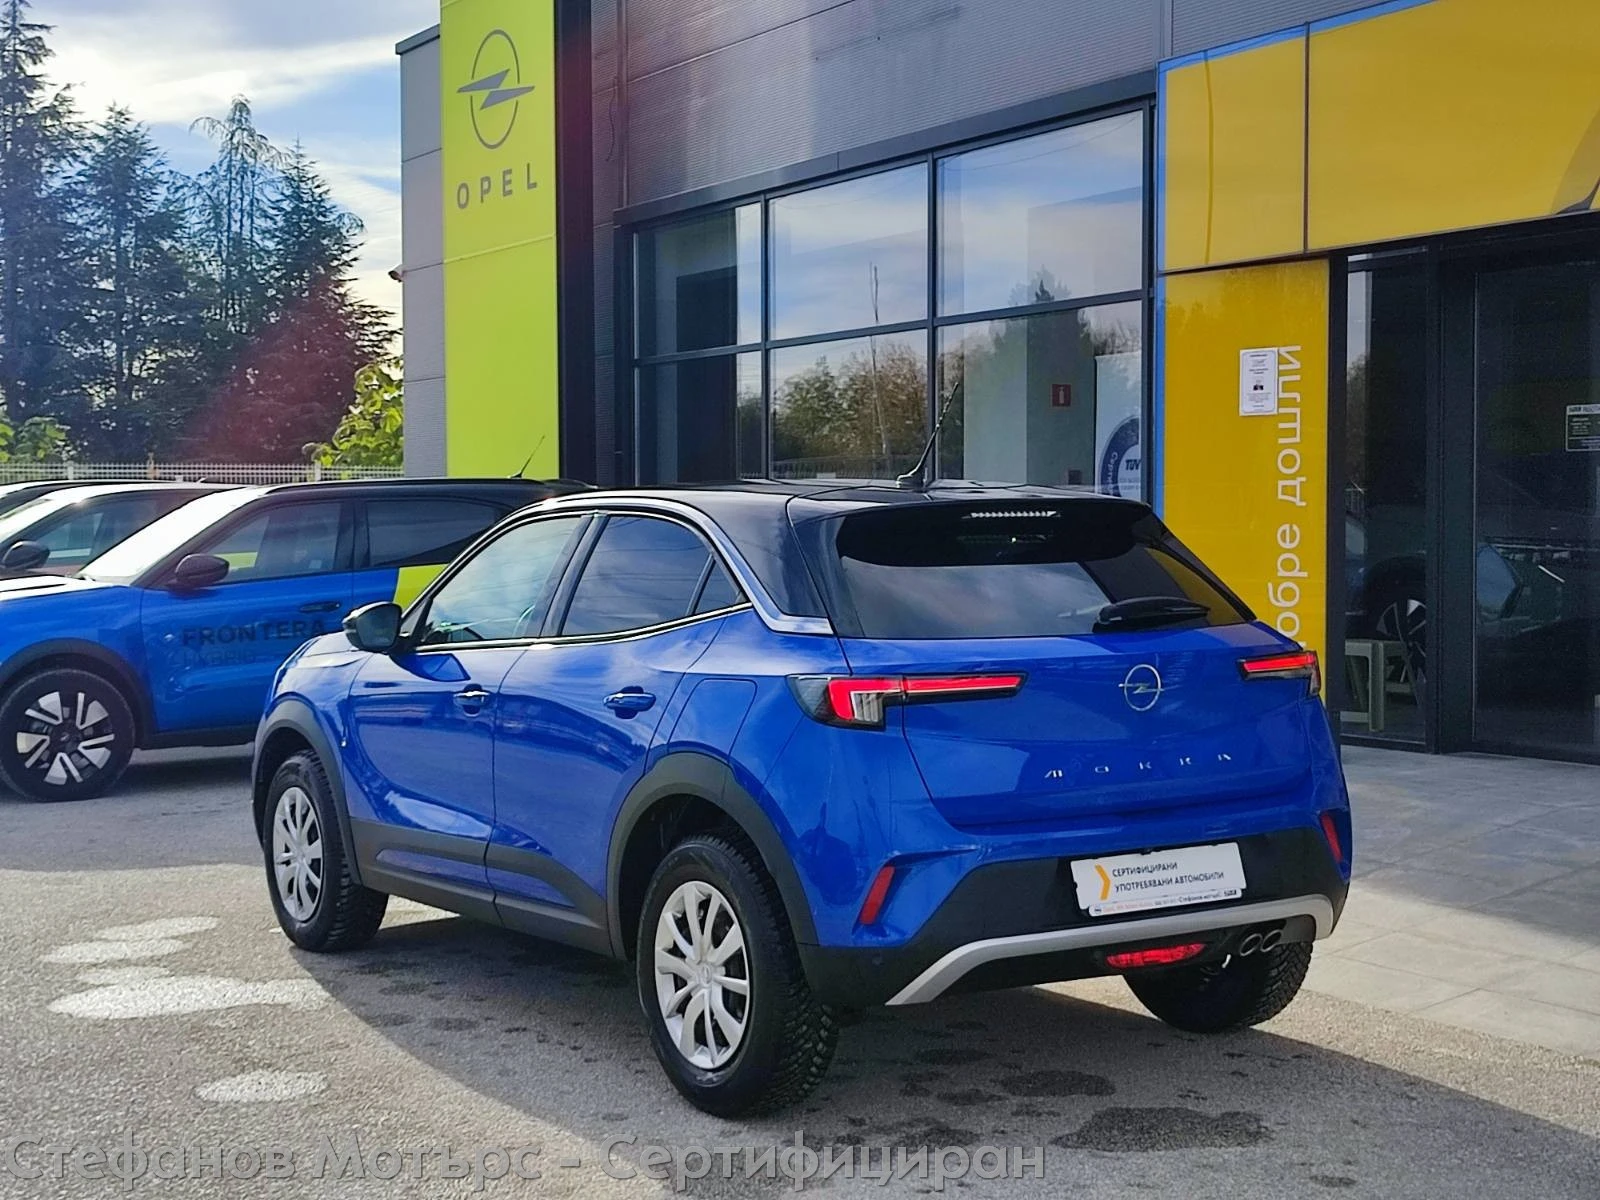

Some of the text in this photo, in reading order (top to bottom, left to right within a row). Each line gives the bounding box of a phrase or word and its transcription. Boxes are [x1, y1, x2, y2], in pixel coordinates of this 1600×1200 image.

[456, 162, 537, 209] OPEL
[1268, 345, 1308, 648] обре дошли
[182, 618, 325, 647] FRONTERA
[1112, 862, 1178, 878] СЕРТИФИЦИРАНИ
[1114, 871, 1225, 893] УПОТРЕБЯВАНИ АВТОМОБИЛИ
